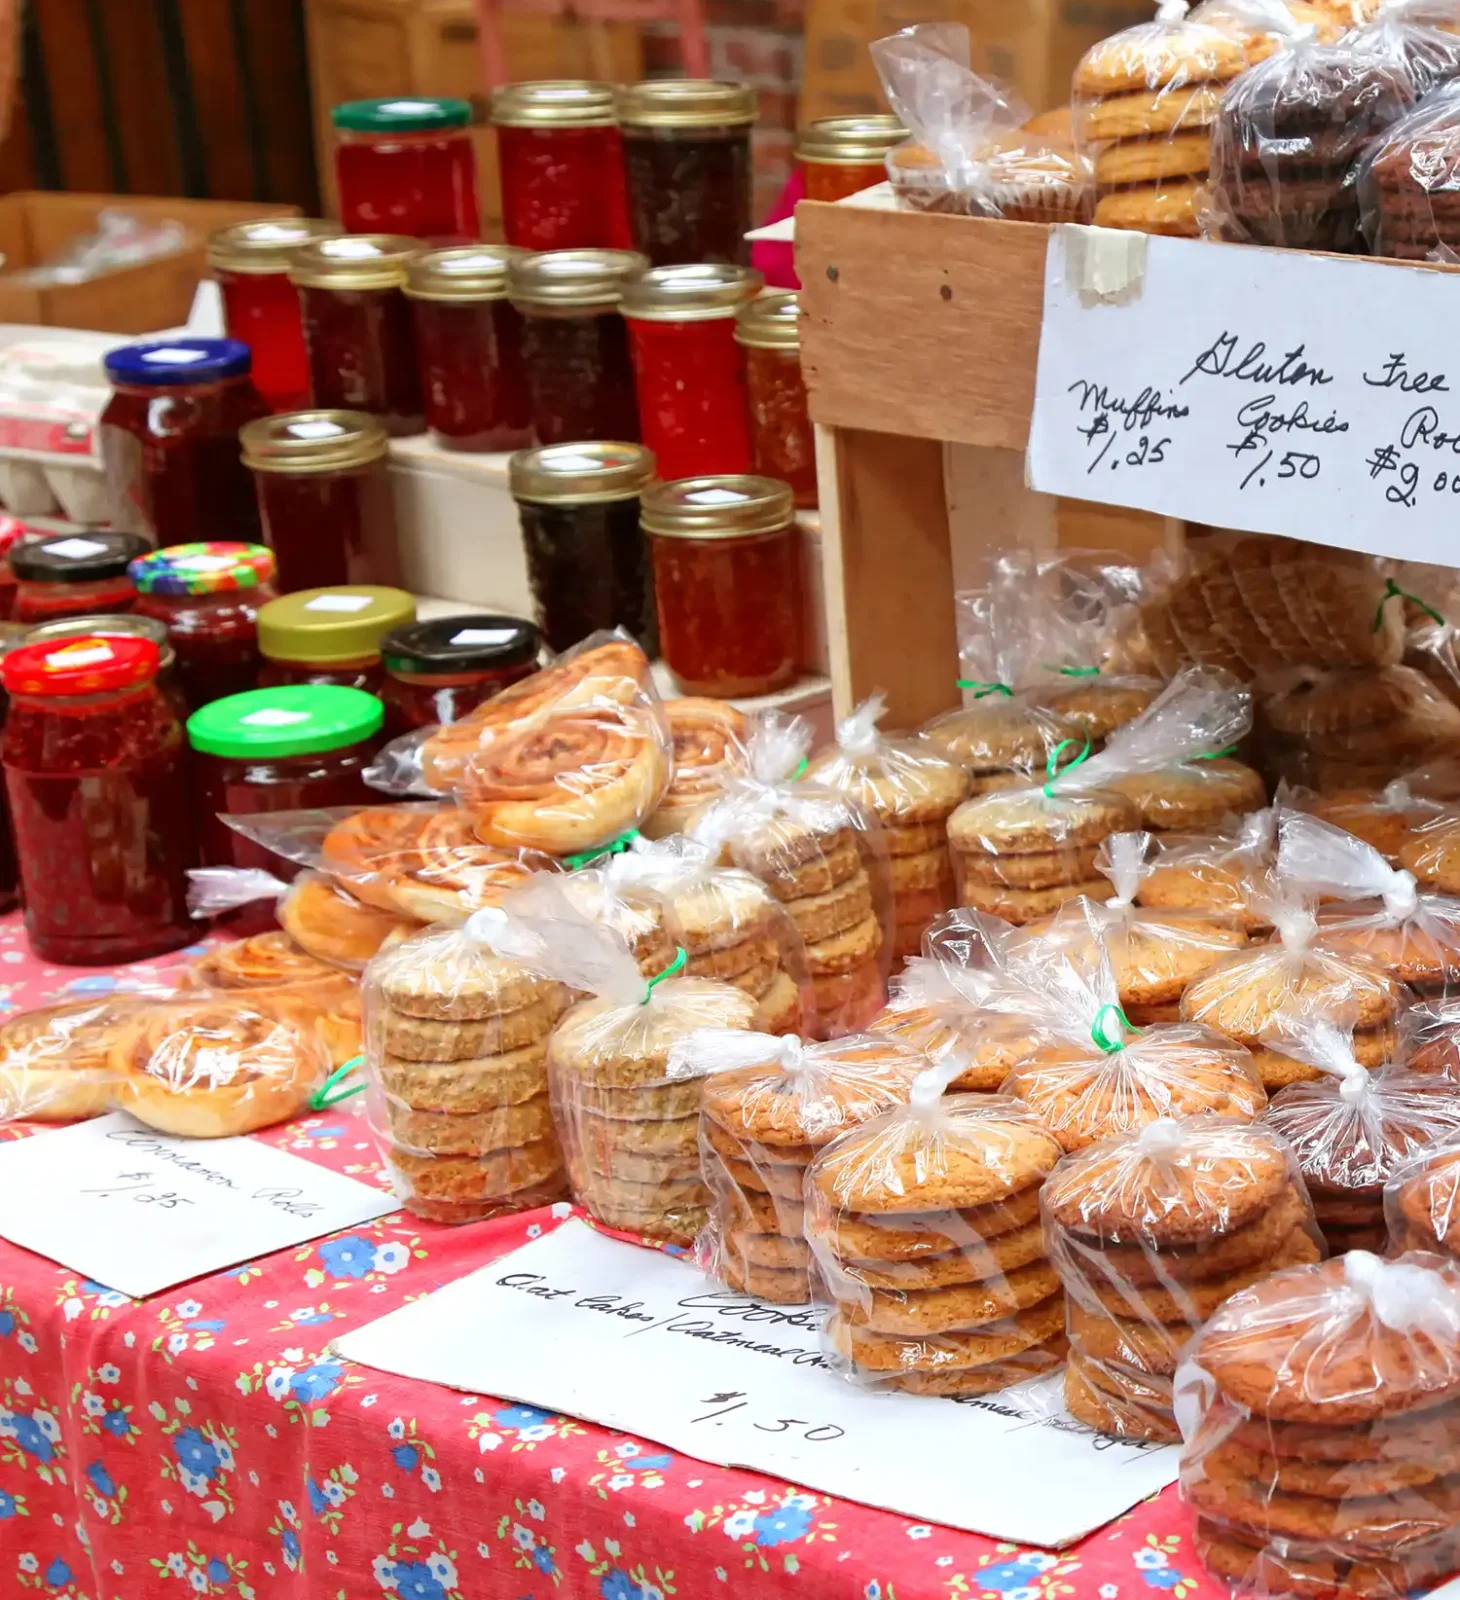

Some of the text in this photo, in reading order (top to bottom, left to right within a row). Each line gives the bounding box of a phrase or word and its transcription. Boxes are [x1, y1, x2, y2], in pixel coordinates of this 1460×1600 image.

[1179, 330, 1450, 394] Gluten Free
[1068, 379, 1190, 431] Muffins
[1237, 394, 1350, 433] Cookies
[1076, 412, 1172, 475] $1.25
[1226, 429, 1321, 490] $1.50
[251, 1186, 325, 1219] Rolls
